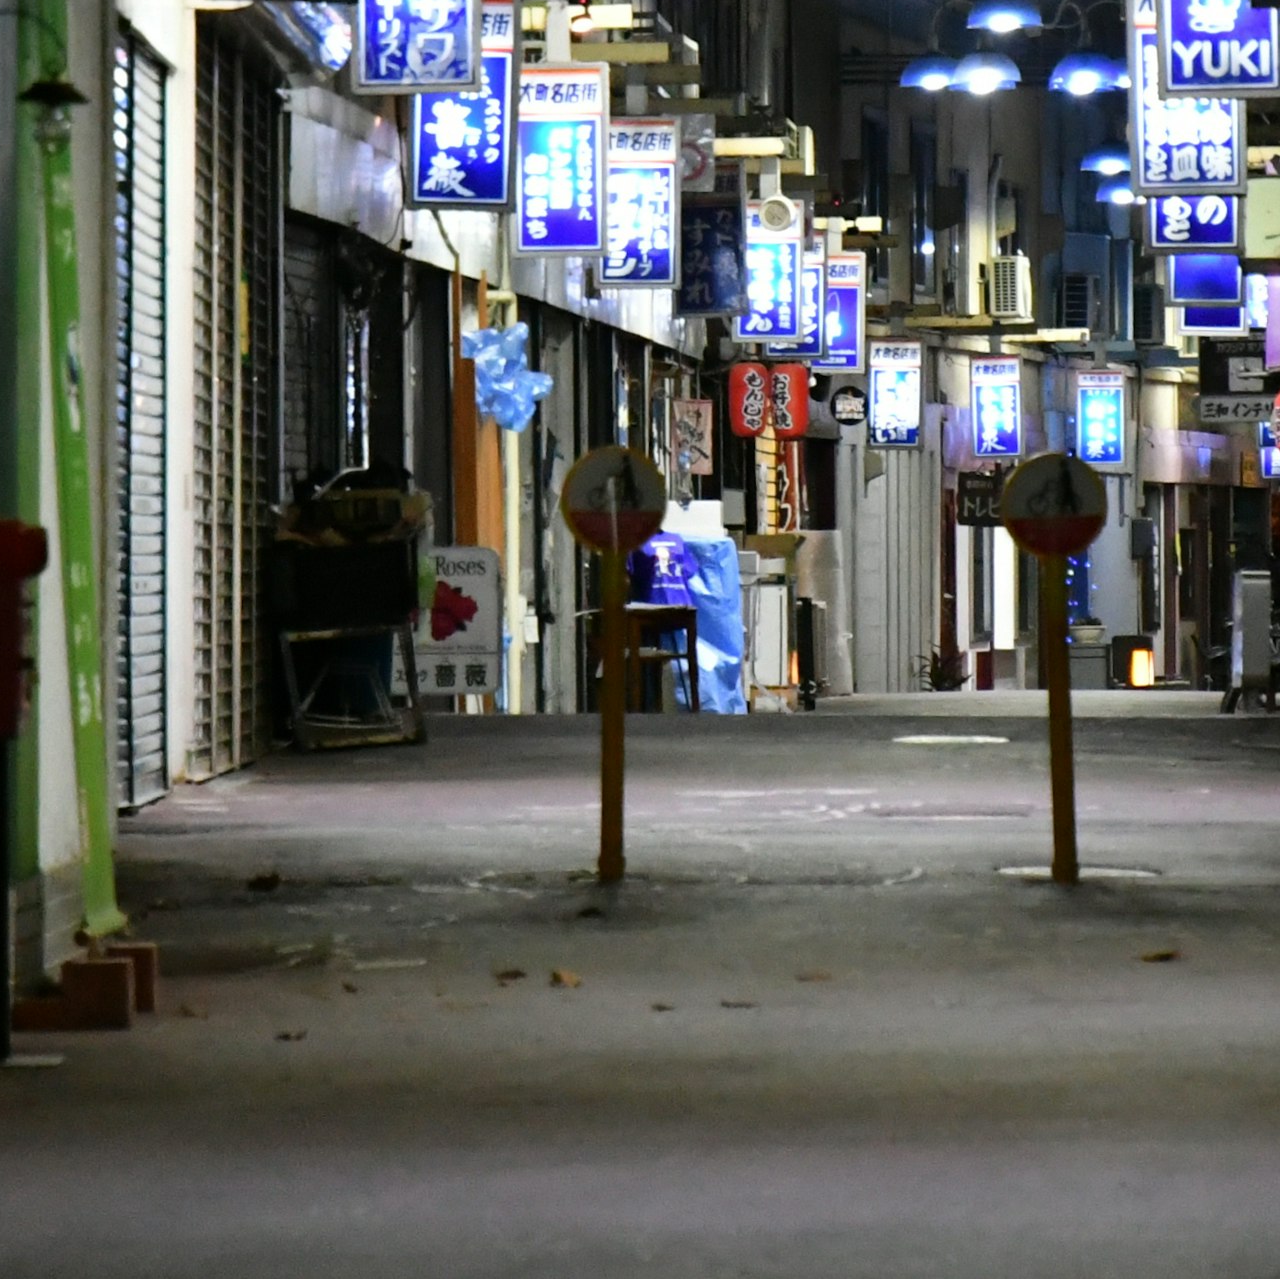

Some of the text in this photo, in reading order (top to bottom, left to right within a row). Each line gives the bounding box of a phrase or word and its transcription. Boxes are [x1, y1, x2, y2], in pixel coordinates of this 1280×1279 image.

[1172, 39, 1271, 78] YUKI
[519, 83, 596, 102] 大町名店街
[743, 369, 764, 431] もんじゃ
[433, 556, 487, 577] Roses
